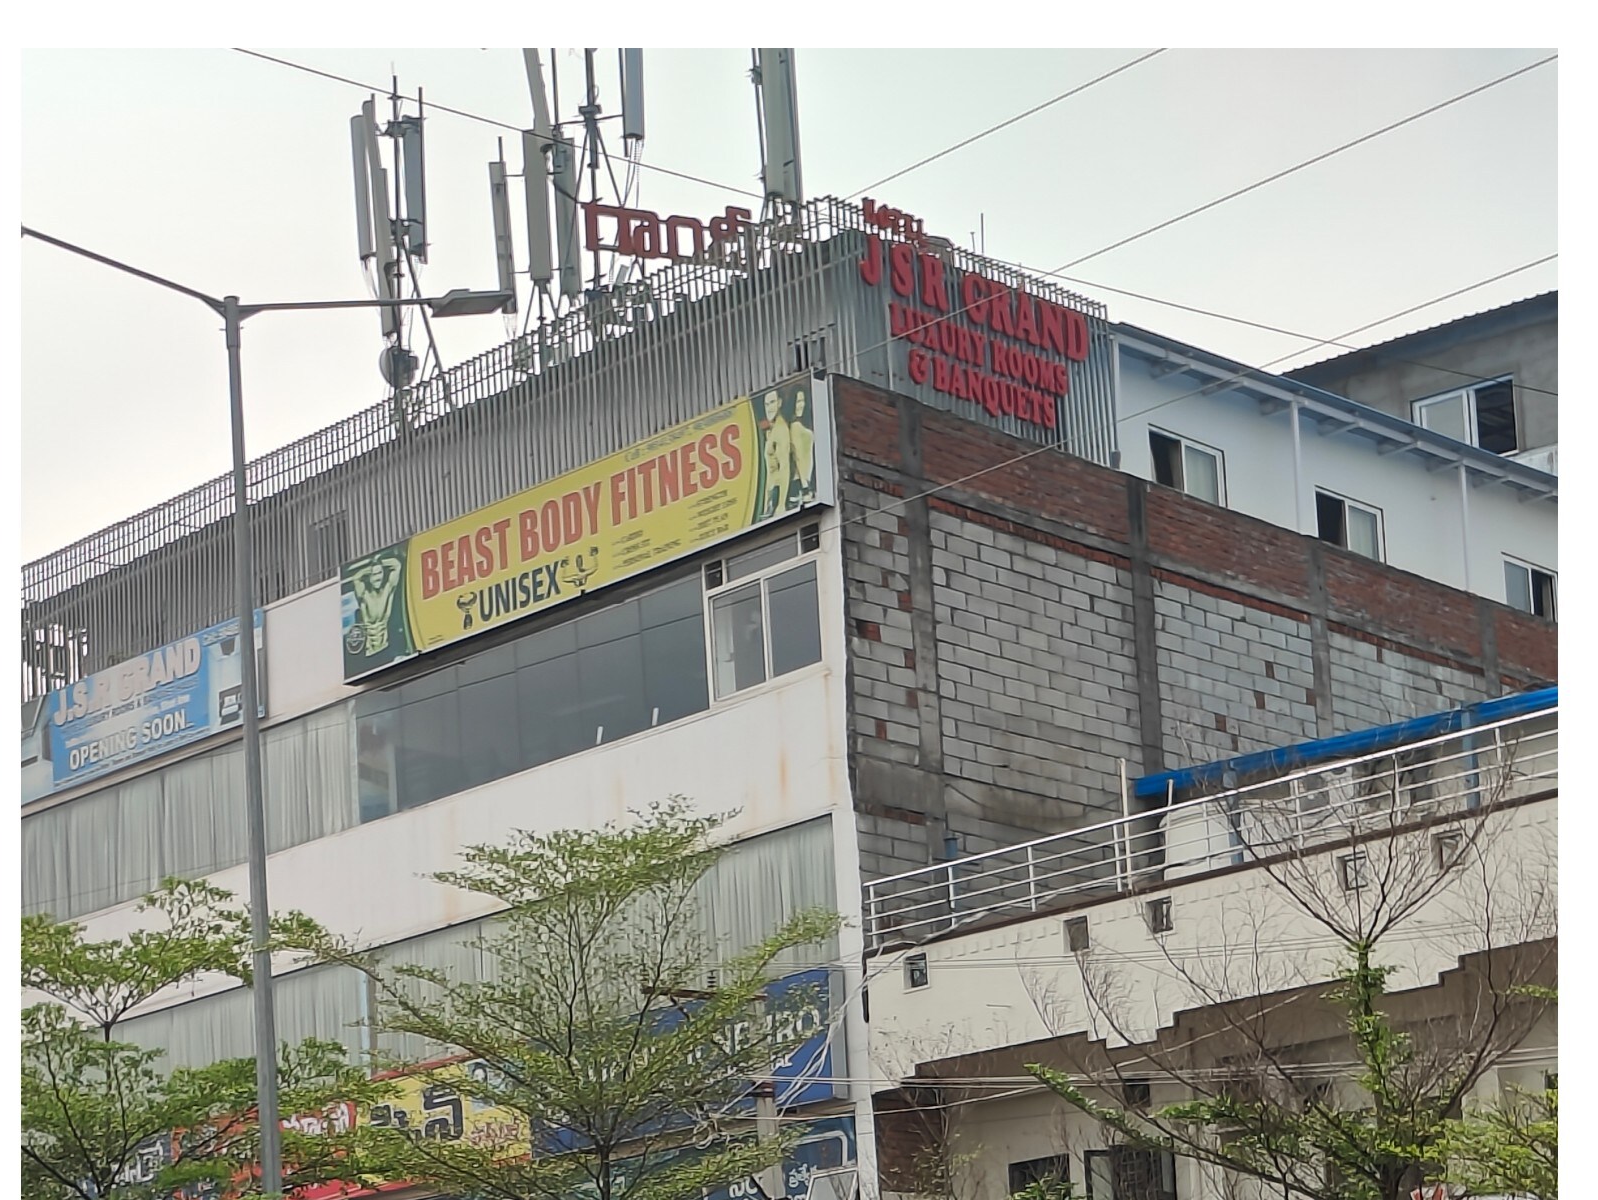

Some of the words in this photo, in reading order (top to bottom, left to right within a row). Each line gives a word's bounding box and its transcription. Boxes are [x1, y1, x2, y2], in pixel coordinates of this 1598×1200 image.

[889, 302, 986, 366] LUXURY
[991, 339, 1068, 396] ROOMS
[962, 272, 1089, 362] GRAND
[932, 356, 1056, 429] BANQUETS
[420, 517, 512, 600] BEAST
[519, 481, 602, 563] BODY
[610, 424, 742, 528] FITNESS
[478, 559, 561, 623] UNISEX
[118, 637, 201, 702] GRAND
[69, 726, 138, 771] OPENING
